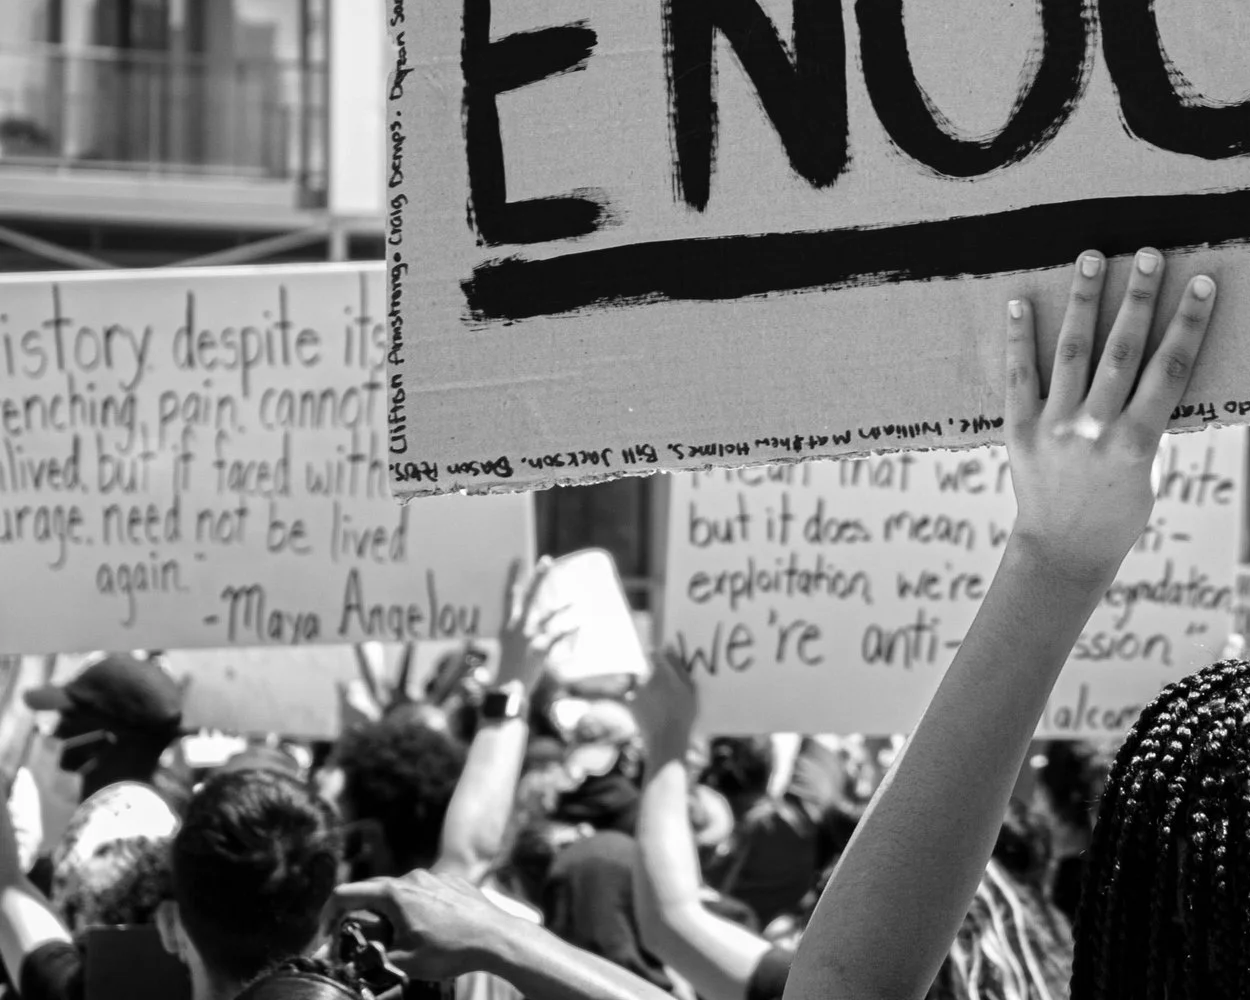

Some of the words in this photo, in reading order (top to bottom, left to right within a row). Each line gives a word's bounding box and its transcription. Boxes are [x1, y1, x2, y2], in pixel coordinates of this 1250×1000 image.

[388, 193, 409, 246] Craig
[172, 284, 322, 396] despite
[0, 371, 137, 455] enching
[259, 369, 384, 432] cannot
[388, 373, 409, 454] Clifton
[95, 422, 157, 494] but
[171, 424, 195, 495] if
[211, 428, 292, 496] faced
[304, 428, 388, 498] with
[521, 447, 613, 469] Jackson.
[621, 443, 659, 464] Bill
[1155, 445, 1236, 506] hite
[101, 491, 184, 547] need
[194, 498, 250, 547] not
[266, 501, 314, 555] be
[329, 500, 411, 565] lived
[687, 491, 751, 549] but
[764, 490, 794, 546] it
[802, 496, 873, 545] does
[883, 511, 976, 550] mean
[337, 566, 482, 641] Angelou
[860, 606, 963, 670] anti-
